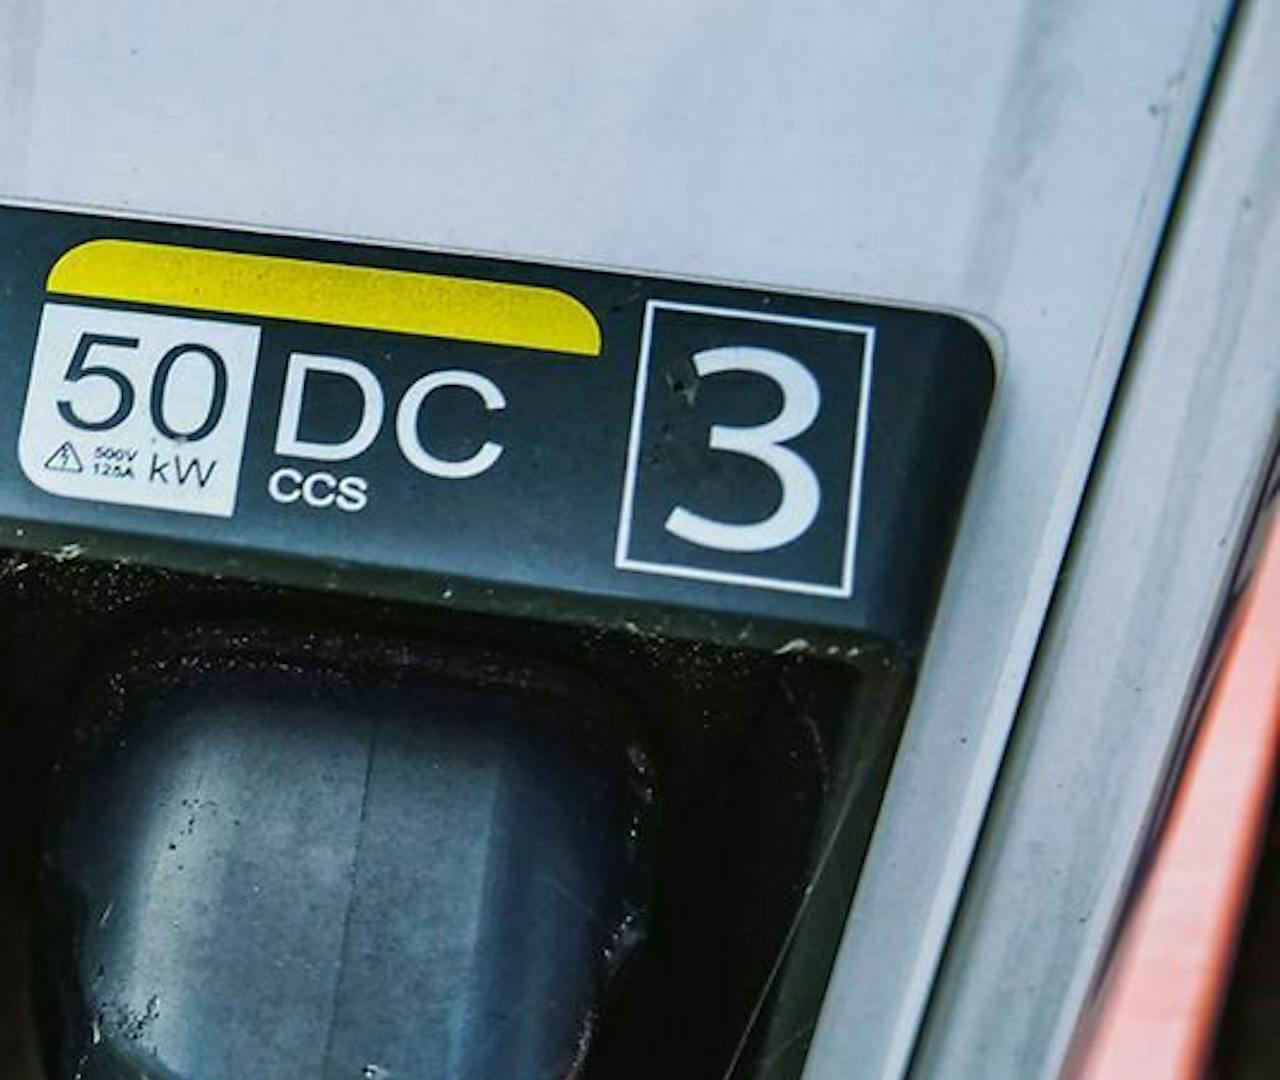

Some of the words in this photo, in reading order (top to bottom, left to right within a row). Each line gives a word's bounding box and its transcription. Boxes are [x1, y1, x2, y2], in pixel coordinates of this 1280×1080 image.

[55, 331, 229, 443] 50
[272, 352, 507, 479] DC
[149, 453, 217, 487] kW
[268, 466, 368, 512] CCS
[665, 345, 822, 552] 3
